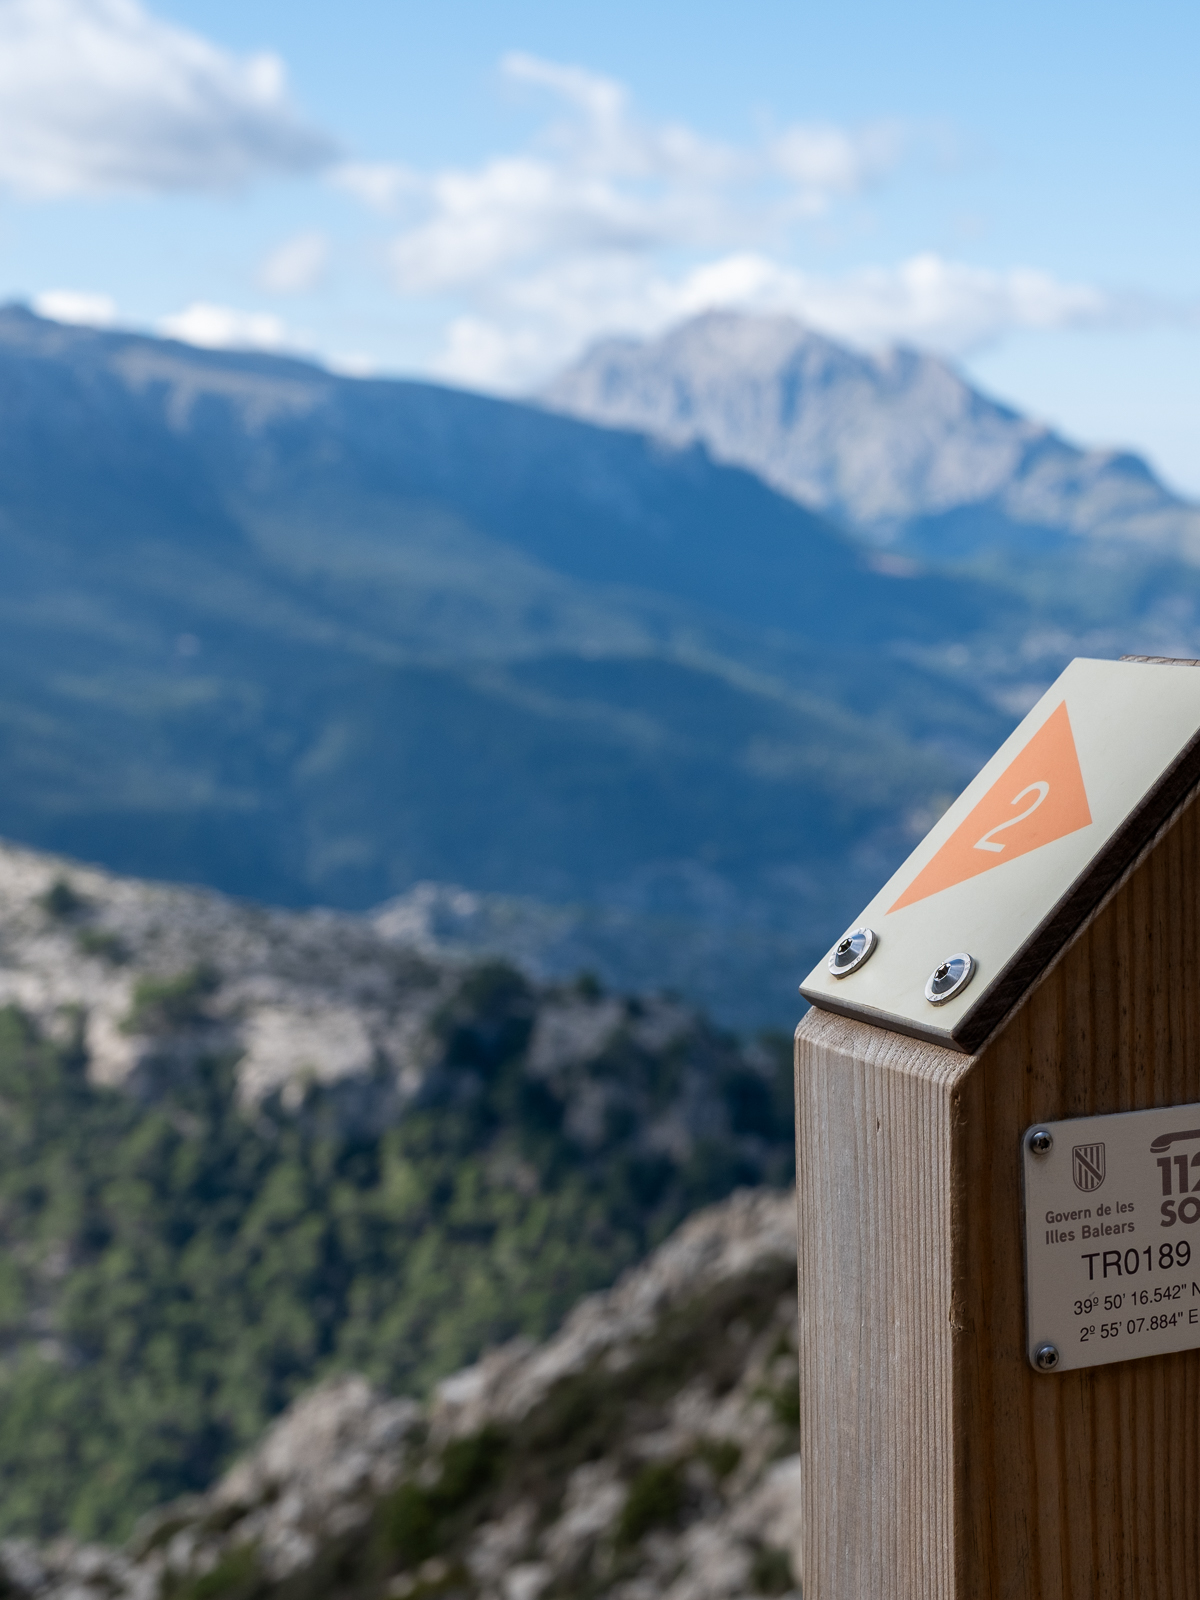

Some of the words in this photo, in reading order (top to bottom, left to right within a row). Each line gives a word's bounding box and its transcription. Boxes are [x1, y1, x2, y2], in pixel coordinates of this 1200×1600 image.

[973, 780, 1050, 853] 2
[1045, 1208, 1092, 1224] Govern
[1096, 1204, 1112, 1217] de
[1116, 1201, 1135, 1213] les
[1045, 1228, 1076, 1245] Illes
[1081, 1221, 1135, 1239] Balears
[1081, 1240, 1191, 1280] TR0189
[1189, 1309, 1199, 1324] E
